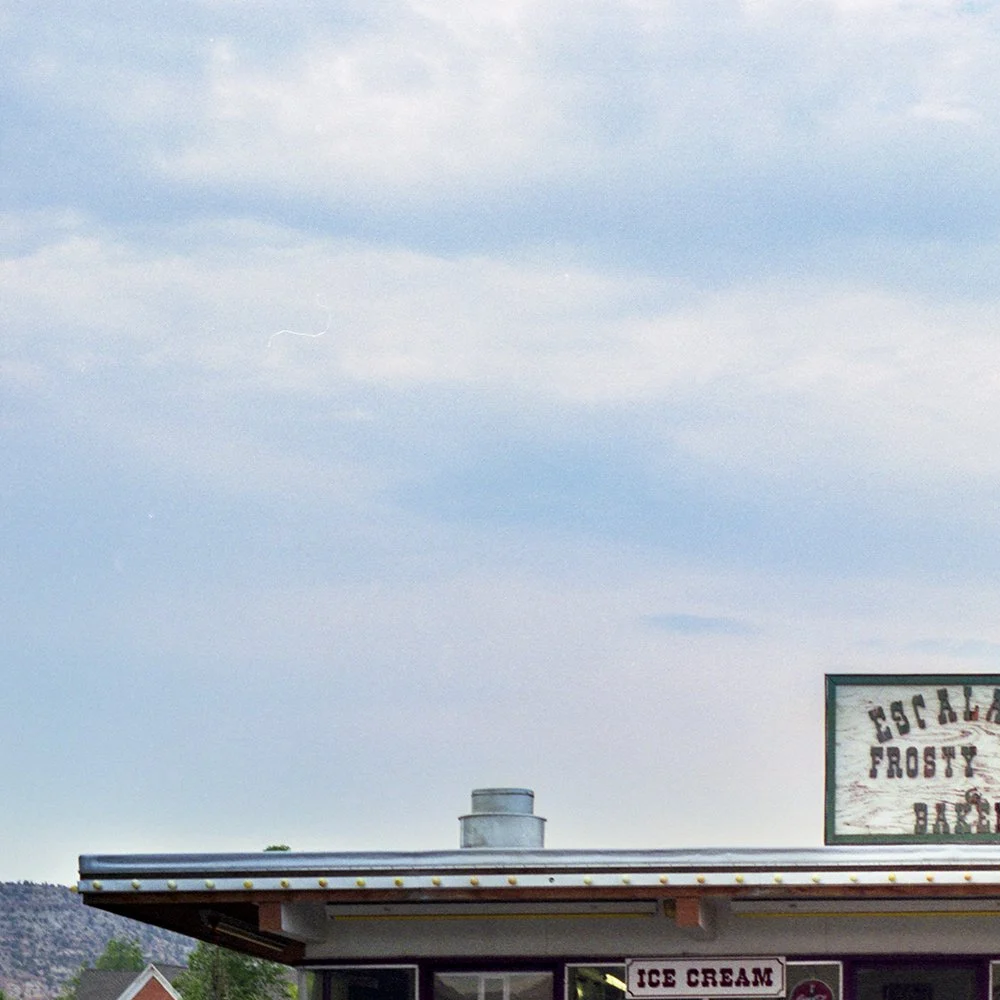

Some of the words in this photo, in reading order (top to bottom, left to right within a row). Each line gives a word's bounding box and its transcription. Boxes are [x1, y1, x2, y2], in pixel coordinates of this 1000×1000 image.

[869, 745, 978, 779] FROSTY
[636, 967, 677, 989] ICE
[685, 967, 774, 988] CREAM
